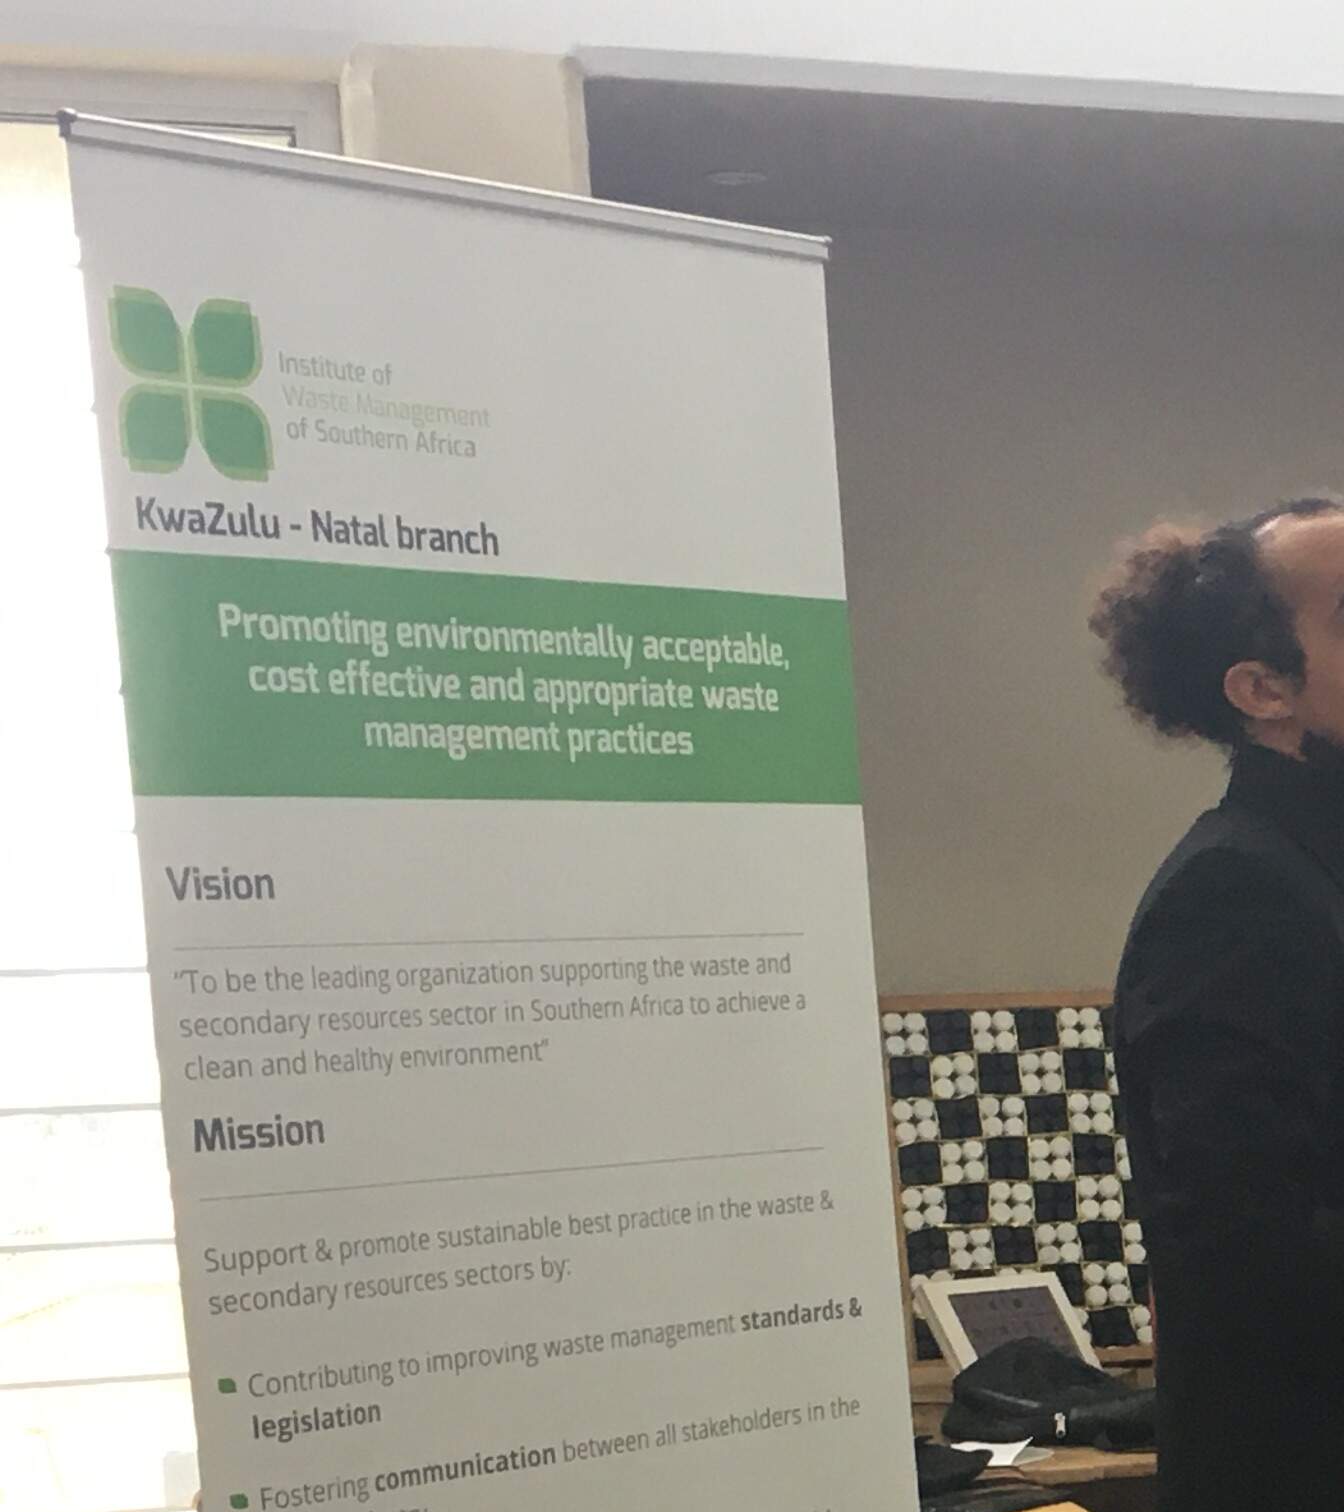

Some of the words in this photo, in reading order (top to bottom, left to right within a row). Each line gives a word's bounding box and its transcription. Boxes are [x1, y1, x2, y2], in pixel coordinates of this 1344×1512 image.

[279, 351, 366, 383] Institute
[372, 363, 392, 386] of
[286, 416, 309, 440] of
[315, 418, 408, 451] Southern
[416, 430, 476, 458] Africa
[136, 496, 280, 539] KwaZulu
[311, 510, 389, 548] Natal
[396, 515, 499, 556] branch
[218, 603, 388, 657] Promoting
[396, 617, 633, 670] environmentally
[643, 631, 789, 673] acceptable,
[249, 662, 320, 693] cost
[328, 659, 461, 699] effective
[470, 667, 525, 702] and
[533, 676, 694, 717] appropriate
[701, 682, 779, 712] waste
[365, 721, 561, 760] management
[567, 722, 694, 763] practices
[165, 866, 275, 901] Vision
[184, 1055, 253, 1080] clean
[261, 1050, 307, 1077] and
[314, 1047, 393, 1077] healthy
[194, 1114, 325, 1153] Mission
[248, 1362, 394, 1397] Contributing
[398, 1358, 420, 1377] to
[427, 1343, 539, 1376] improving
[544, 1334, 604, 1358] waste
[611, 1314, 735, 1348] management
[740, 1298, 844, 1332] standards
[849, 1297, 862, 1318] &
[252, 1403, 381, 1443] legislation
